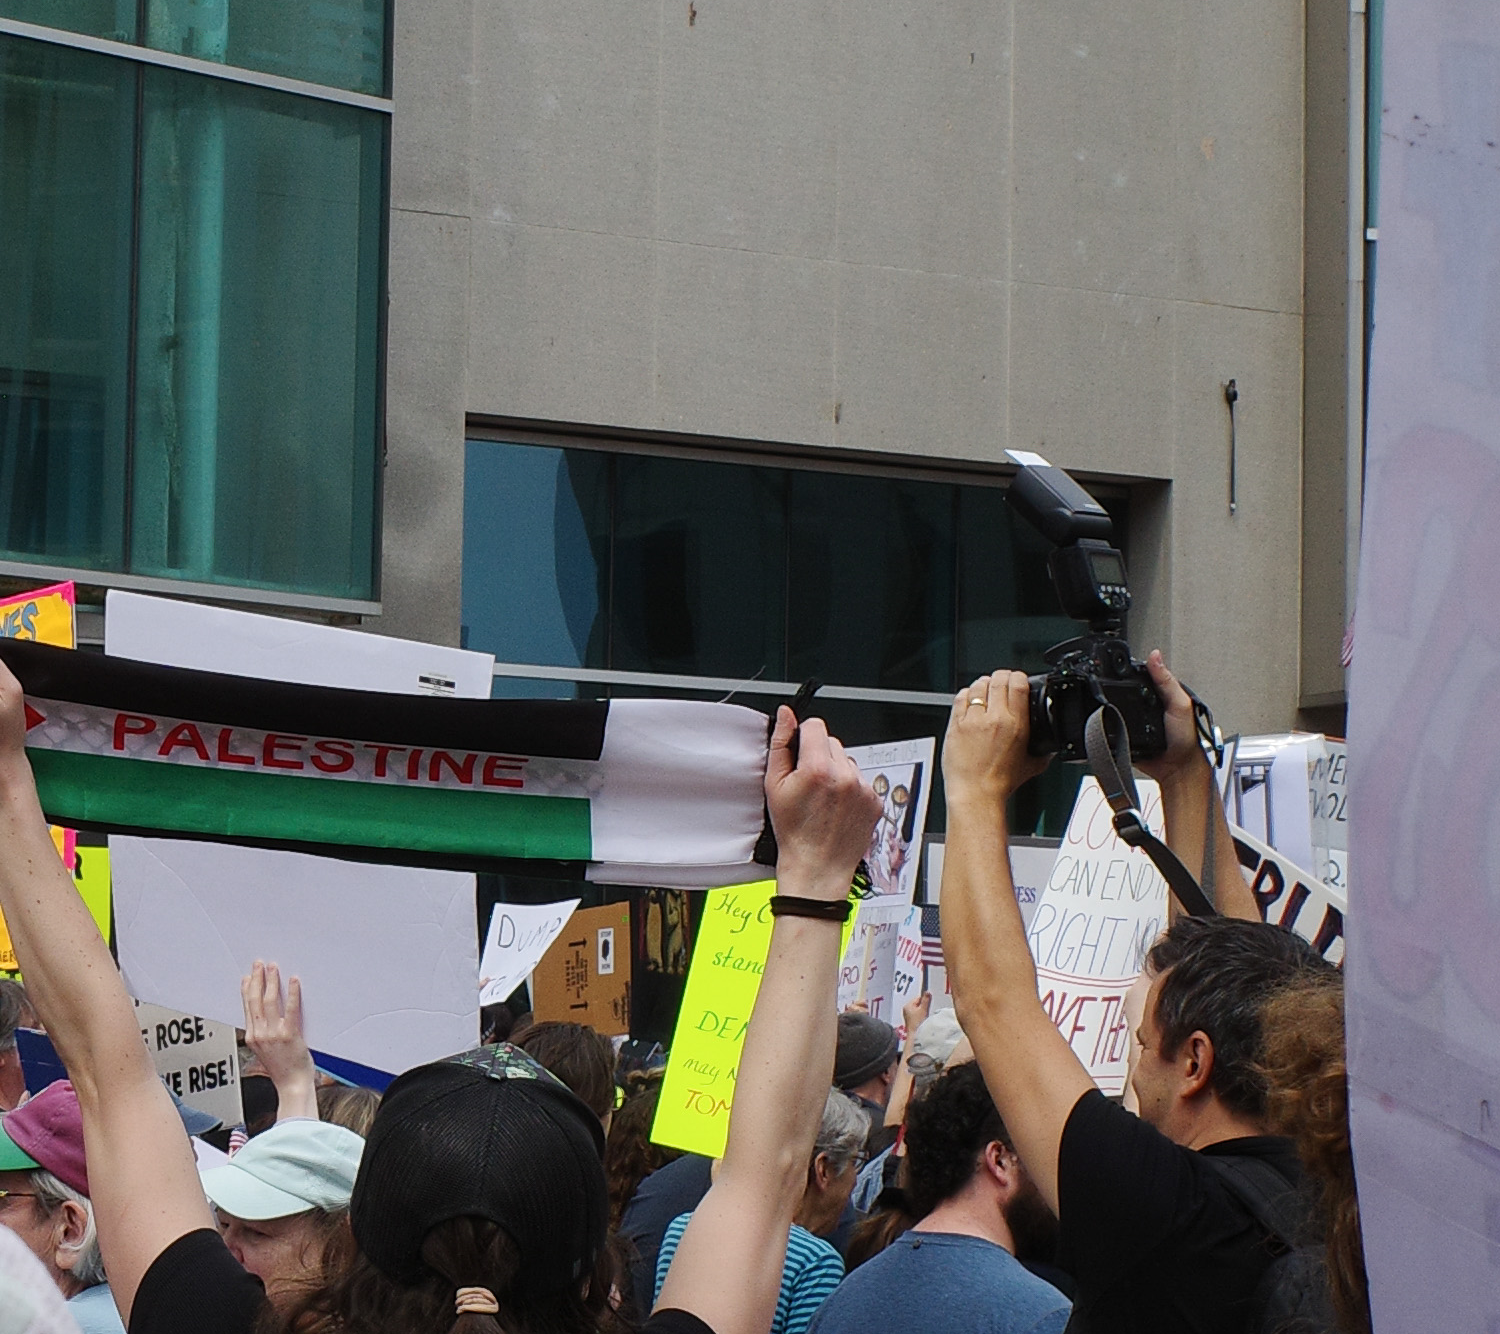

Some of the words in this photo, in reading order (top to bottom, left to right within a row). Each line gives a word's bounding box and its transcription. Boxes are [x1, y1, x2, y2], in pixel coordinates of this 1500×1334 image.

[111, 710, 531, 790] PALESTINE
[1049, 854, 1100, 899] CAN
[1100, 860, 1154, 903] END
[714, 892, 752, 934] Hey
[1027, 903, 1129, 975] RIGHT
[155, 1015, 214, 1052] ROSE.
[188, 1054, 235, 1094] RISE!
[683, 1058, 721, 1086] may
